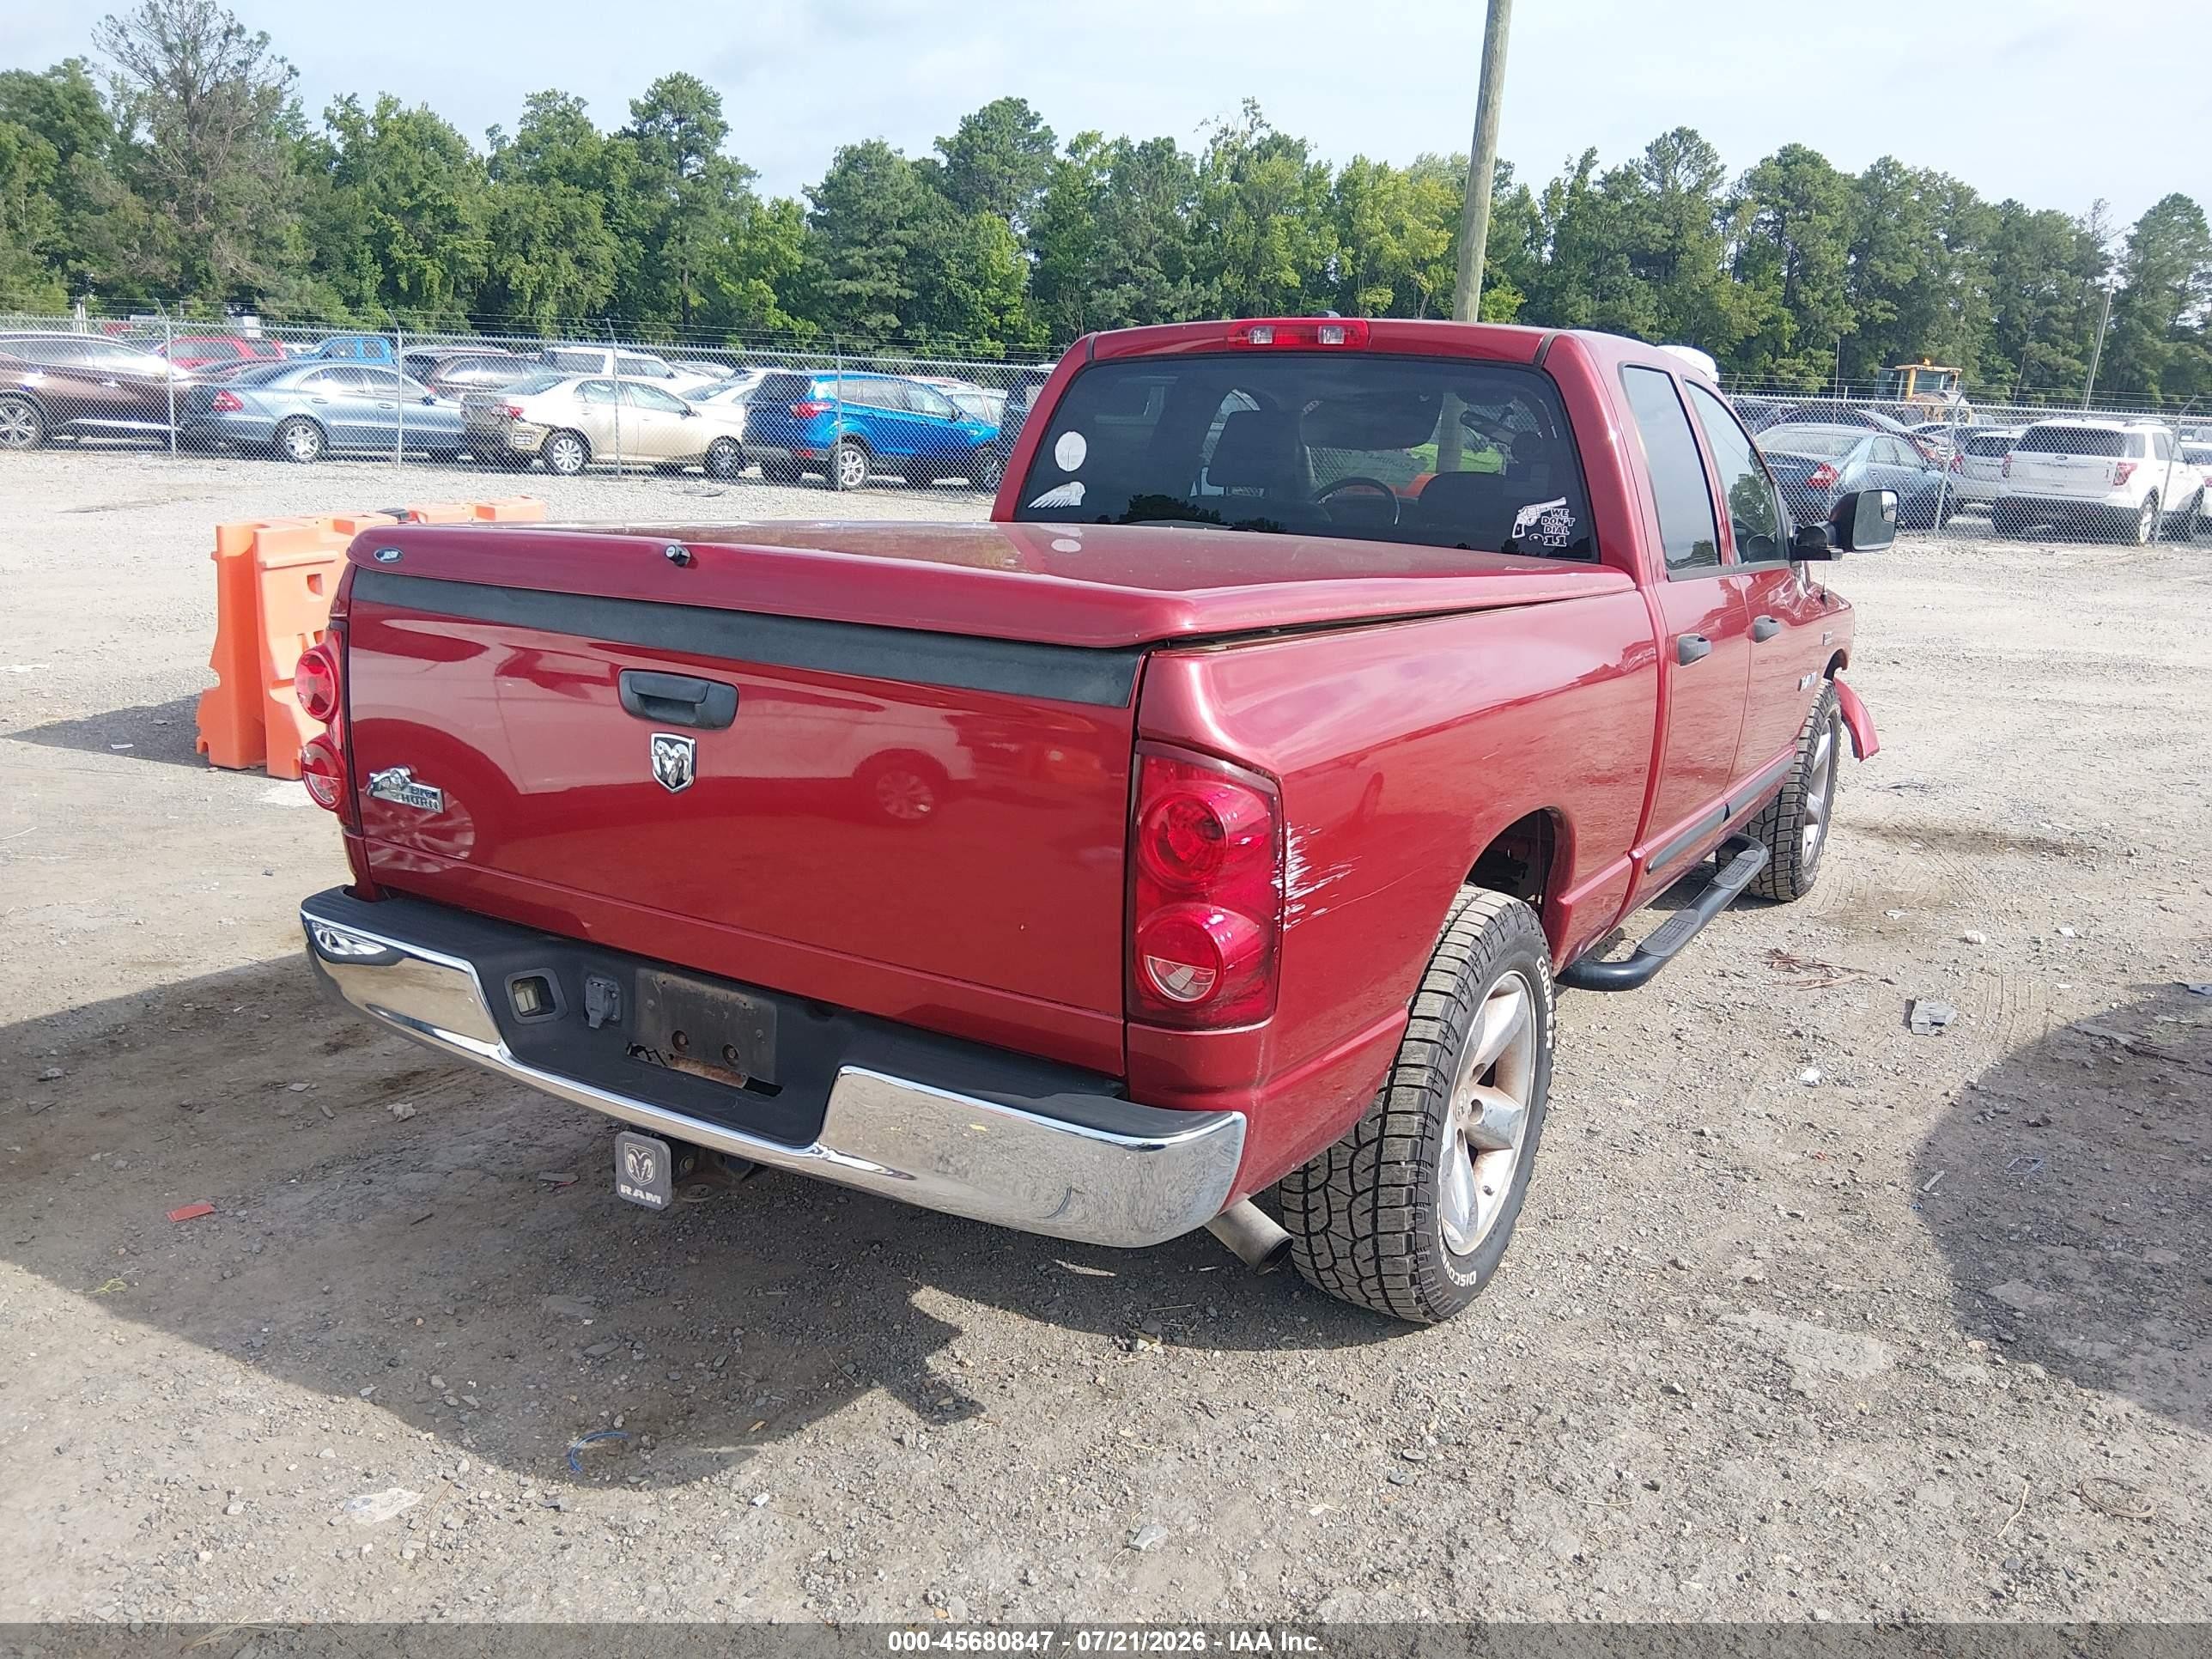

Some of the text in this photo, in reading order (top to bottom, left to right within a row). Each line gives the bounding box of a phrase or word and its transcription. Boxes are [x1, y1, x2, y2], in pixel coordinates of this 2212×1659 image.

[1550, 507, 1570, 517] WE
[1541, 515, 1576, 526] DON'T
[1543, 525, 1571, 536] DIAL
[401, 793, 440, 810] HORN
[1535, 955, 1553, 1049] COOPER
[620, 1183, 662, 1205] RAM
